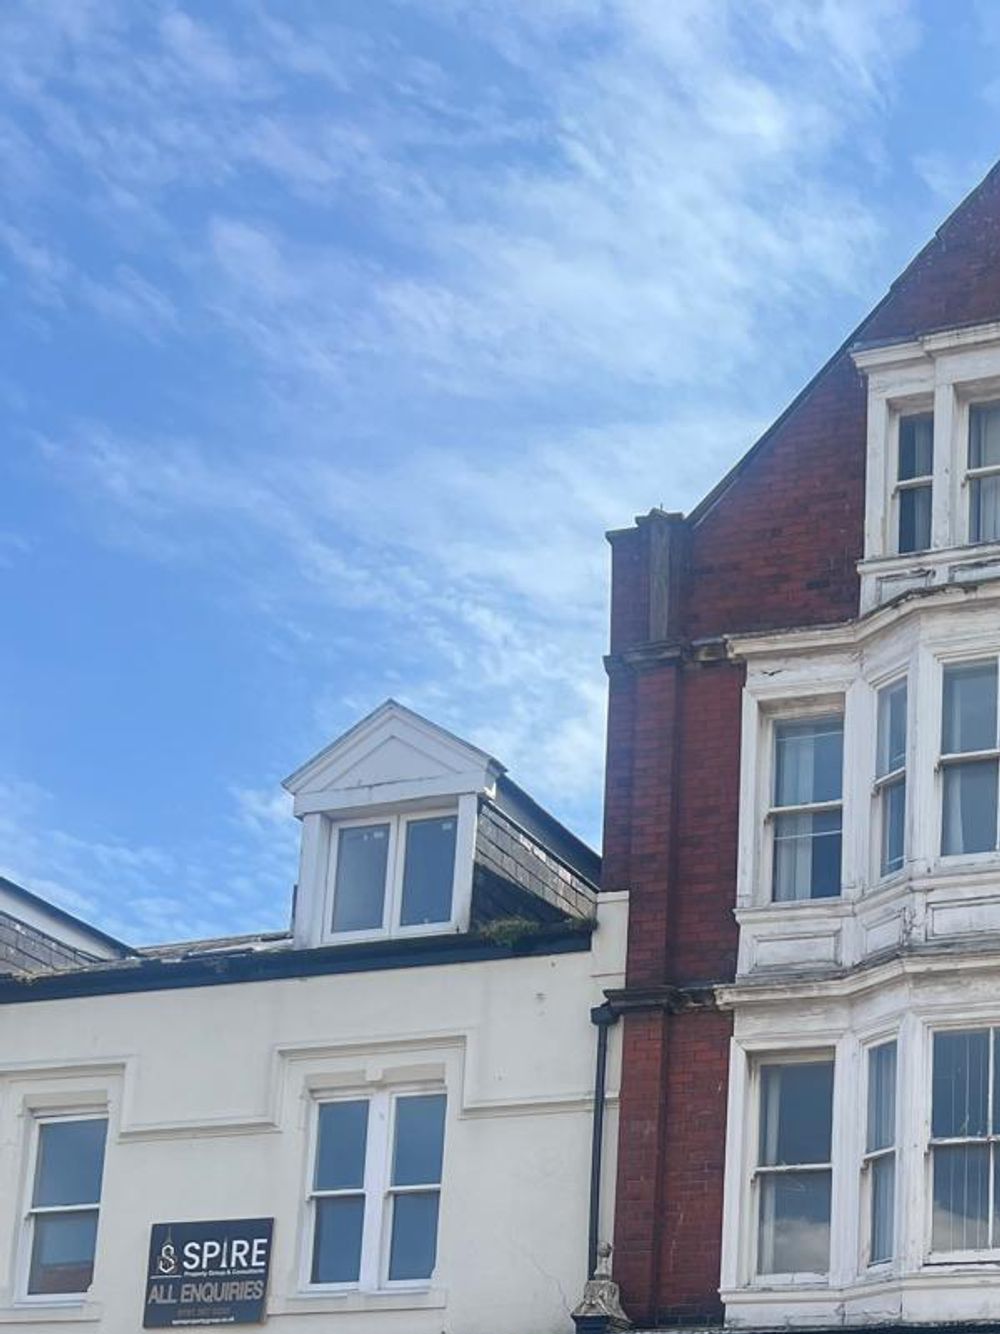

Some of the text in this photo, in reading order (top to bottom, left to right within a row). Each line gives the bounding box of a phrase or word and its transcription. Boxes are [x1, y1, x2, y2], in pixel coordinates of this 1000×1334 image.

[183, 1236, 268, 1269] SPIRE
[147, 1280, 264, 1304] ALL ENQUIRIES
